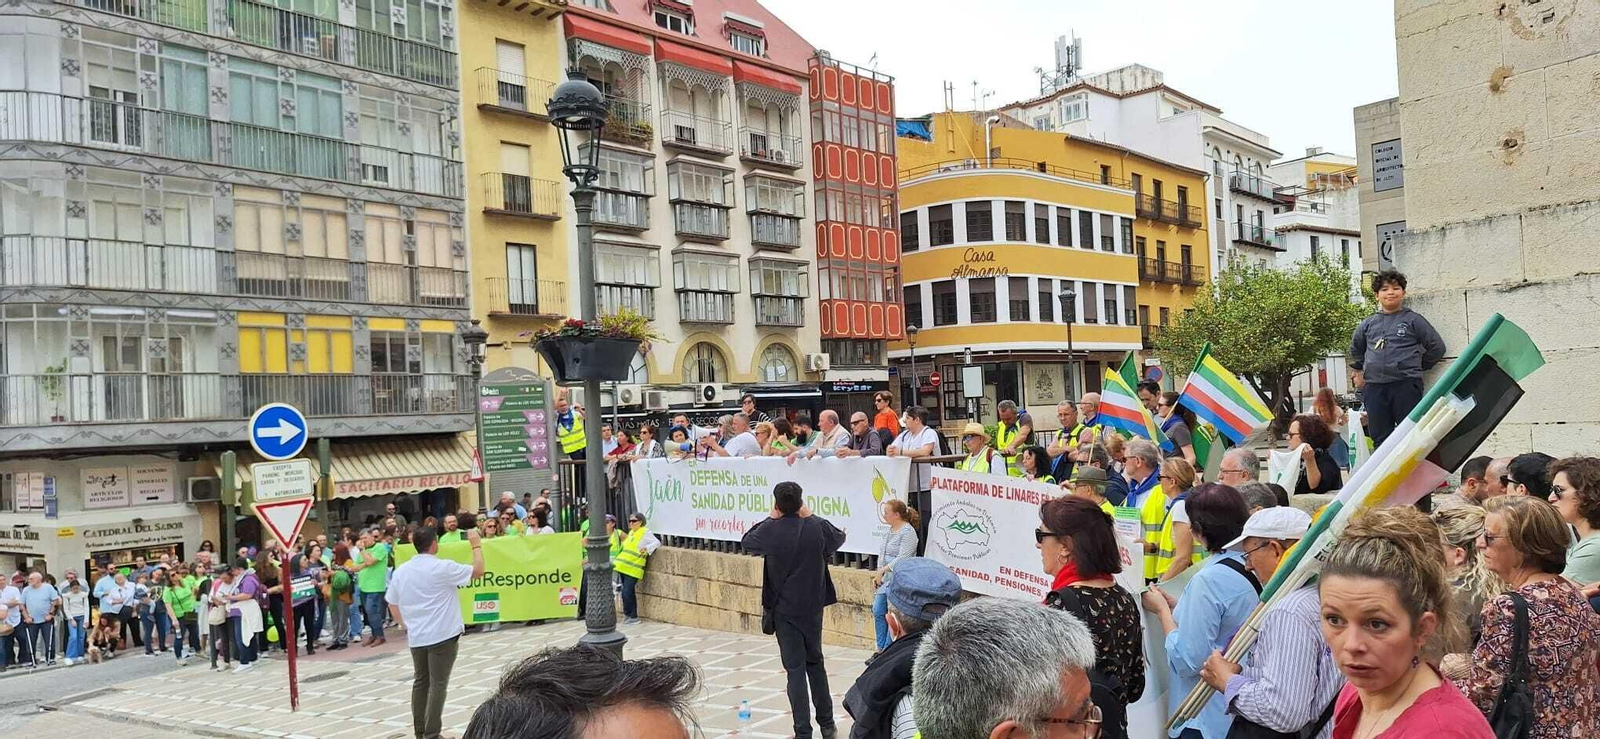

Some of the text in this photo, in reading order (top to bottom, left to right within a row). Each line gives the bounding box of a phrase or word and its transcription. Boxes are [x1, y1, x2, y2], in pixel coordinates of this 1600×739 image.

[963, 247, 996, 263] Casa
[950, 264, 1011, 279] Almansa
[339, 477, 415, 494] SAGITARIO
[690, 470, 768, 487] DEFENSA DE UNA
[932, 477, 990, 497] PLATAFORMA
[991, 484, 1003, 499] DE
[1006, 486, 1040, 506] LINARES
[691, 492, 734, 511] SANIDAD
[999, 565, 1012, 576] EN
[1014, 571, 1049, 588] DEFENSA
[476, 601, 496, 610] USO
